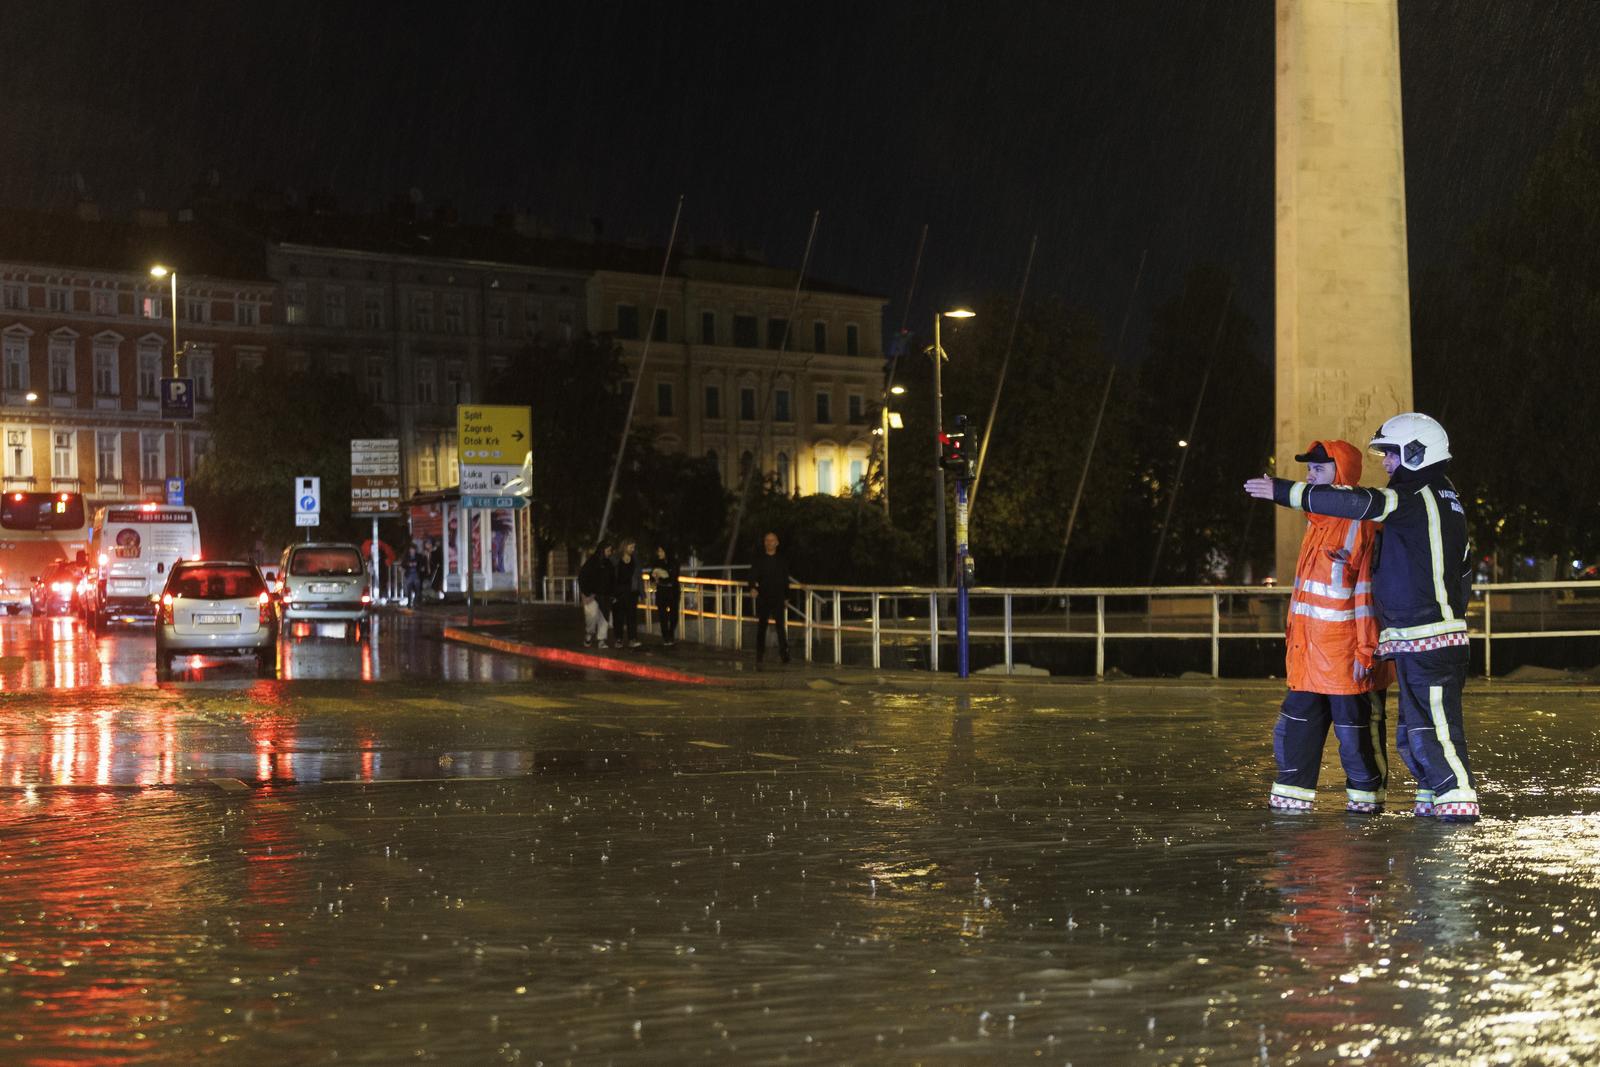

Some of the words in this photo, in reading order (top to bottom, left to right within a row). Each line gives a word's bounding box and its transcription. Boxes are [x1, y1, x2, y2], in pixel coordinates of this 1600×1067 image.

[464, 411, 482, 421] Split
[464, 424, 493, 434] Zagreb
[464, 437, 482, 445] Otok
[486, 437, 500, 445] Krk
[464, 470, 482, 478] Luka
[464, 480, 488, 490] Sušak
